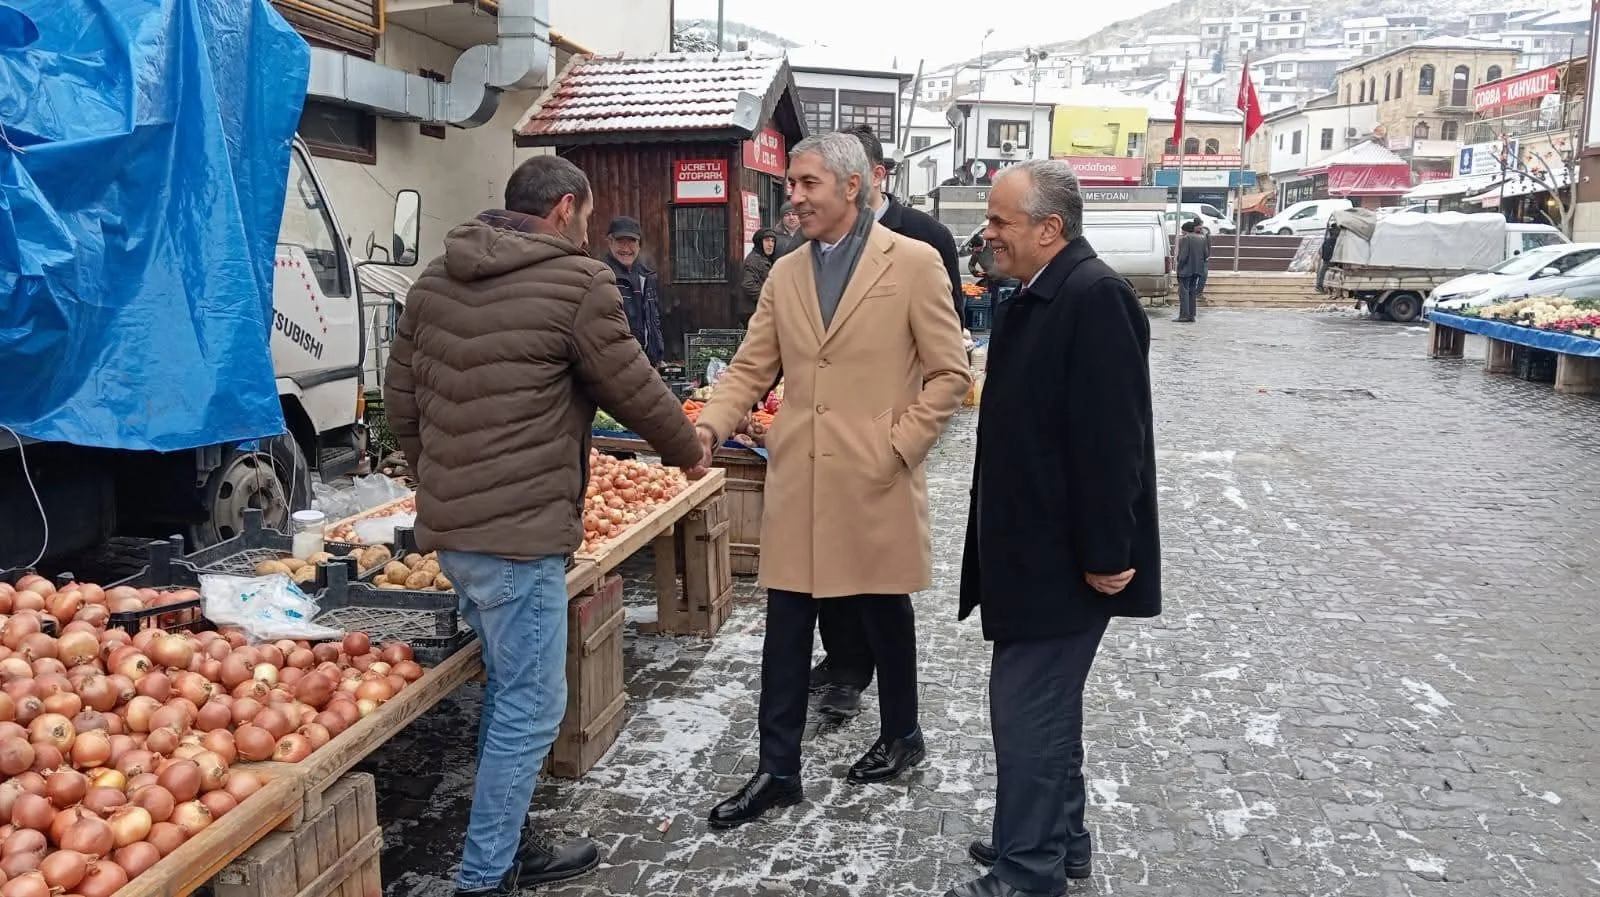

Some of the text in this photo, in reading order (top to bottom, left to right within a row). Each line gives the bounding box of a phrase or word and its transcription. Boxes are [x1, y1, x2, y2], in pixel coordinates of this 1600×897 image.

[1507, 73, 1550, 99] KAHVALTI
[1073, 162, 1117, 172] vodafone
[678, 171, 723, 180] OTOPARK
[977, 191, 1129, 201] 15 MEYDANI
